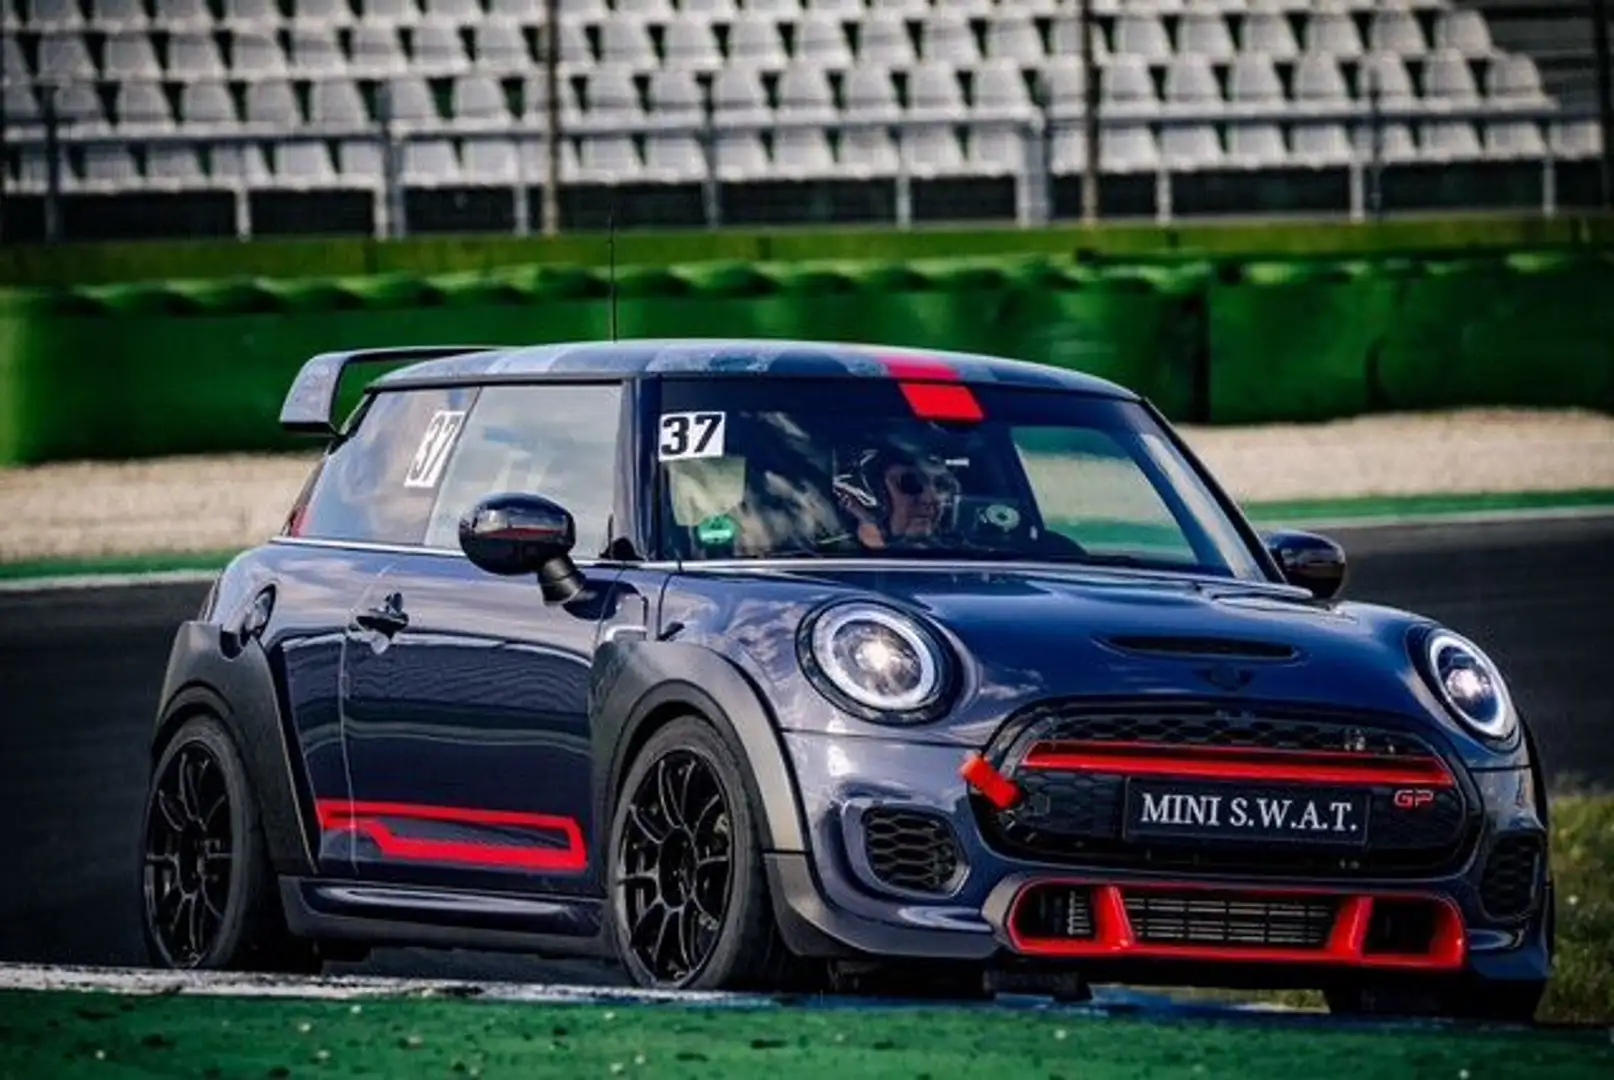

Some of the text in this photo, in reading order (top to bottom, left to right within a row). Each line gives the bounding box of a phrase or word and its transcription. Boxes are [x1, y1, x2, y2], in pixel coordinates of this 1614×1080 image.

[407, 414, 461, 482] 37
[661, 413, 722, 455] 37
[1141, 793, 1358, 831] MINI S.W.A.T.
[1394, 789, 1434, 808] GP
